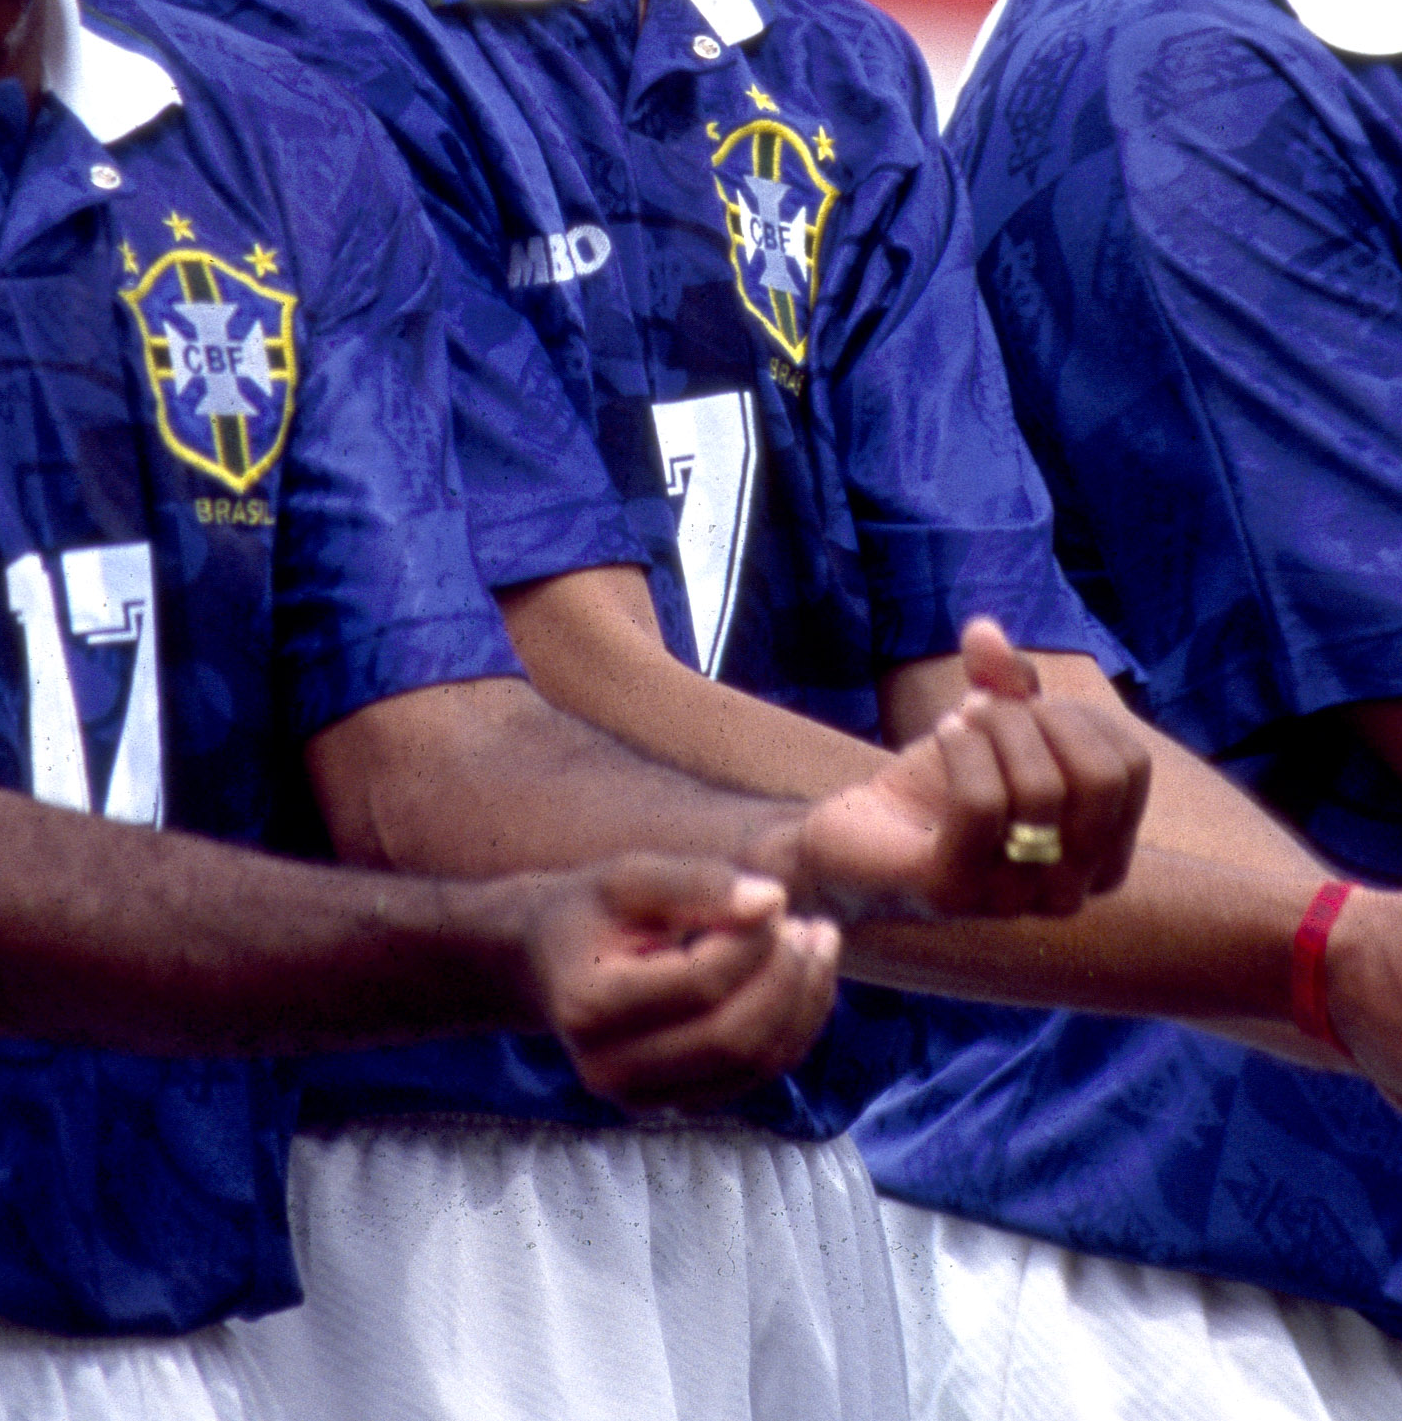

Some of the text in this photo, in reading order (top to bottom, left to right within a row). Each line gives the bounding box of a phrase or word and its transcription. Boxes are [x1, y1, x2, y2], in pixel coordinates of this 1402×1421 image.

[750, 217, 791, 254] CBF
[183, 345, 243, 374] CBF
[651, 391, 757, 680] 7
[5, 541, 164, 831] 17
